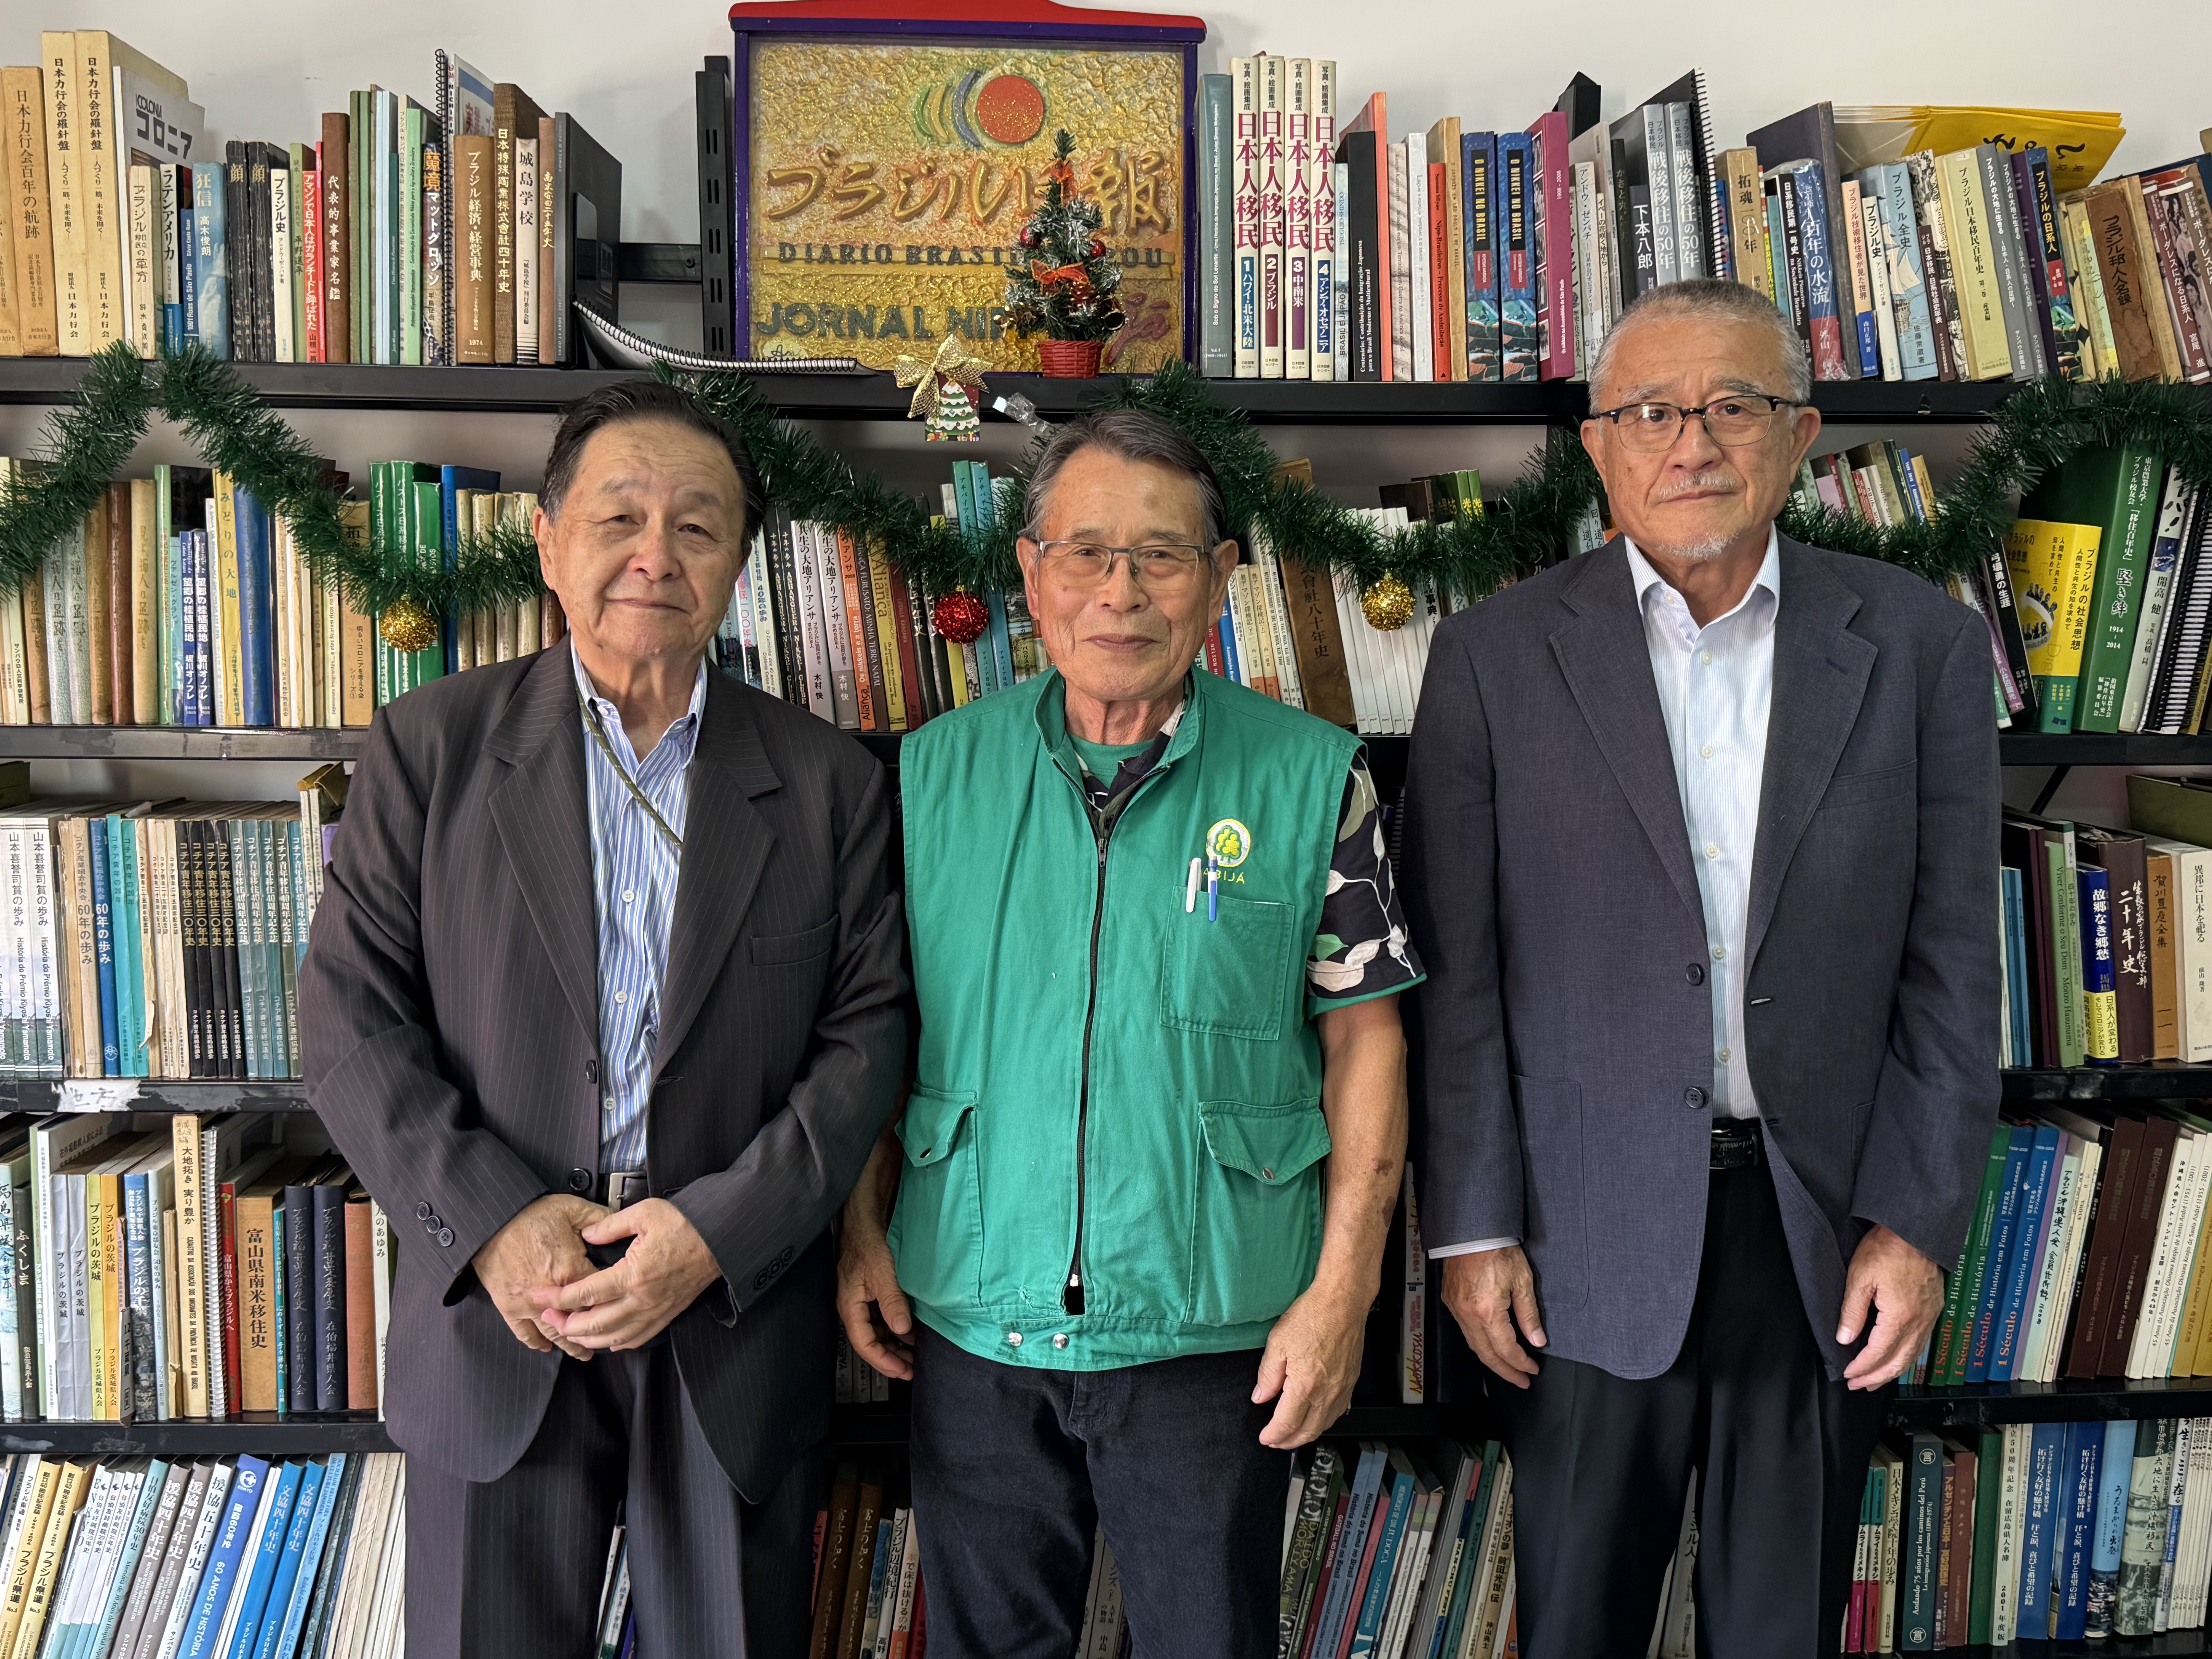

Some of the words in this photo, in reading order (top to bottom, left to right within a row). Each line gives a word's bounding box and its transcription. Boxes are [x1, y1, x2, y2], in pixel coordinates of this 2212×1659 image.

[53, 58, 70, 151] 日本力行会の羅針盤
[86, 57, 104, 151] 日本力行会の羅針盤
[135, 109, 193, 160] コロニア
[1648, 121, 1656, 148] 日本移民
[1656, 119, 1664, 148] ブラジル
[17, 89, 40, 239] 日本力行会百年の航跡
[230, 163, 245, 183] 顔
[252, 163, 266, 183] 顔
[423, 152, 442, 191] 魔境
[1235, 113, 1259, 251] 日本人移民
[1260, 111, 1283, 249] 日本人移民
[1287, 113, 1310, 251] 日本人移民
[1312, 115, 1336, 254] 日本人移民
[1475, 167, 1485, 194] NIKKEI
[1511, 167, 1520, 194] NIKKEI
[196, 173, 212, 208] 狂信
[274, 177, 287, 234] ブラジル史
[519, 152, 534, 226] 城島学校
[1475, 198, 1485, 209] NO
[1511, 198, 1521, 209] NO
[1580, 168, 1591, 240] アンドウ・ゼンパチ
[1649, 151, 1674, 270] 戦後移住の50年
[1892, 172, 1912, 250] ブラジル全史
[1986, 157, 2004, 234] ブラジルの大地に生きる
[2035, 170, 2058, 254] ブラジルの日系人
[161, 170, 175, 262] ラテンアメリカ
[200, 215, 211, 257] 高木俊朗
[328, 175, 342, 300] 代表的事業家名鑑
[428, 192, 441, 287] マットグロッソ
[468, 151, 483, 282] ブラジル経済・経営事典
[1476, 213, 1486, 241] BRASIL
[1511, 213, 1522, 241] BRASIL
[1633, 204, 1653, 270] 下本八郎
[1784, 182, 1800, 256] 日系移民第一号史
[1866, 204, 1882, 258] ブラジル史
[778, 242, 892, 265] DIARIO
[1244, 260, 1250, 272] 1
[1267, 258, 1276, 270] 2
[1293, 260, 1303, 273] 3
[1848, 187, 1868, 301] ブラジル技術移住者が見た世界
[1266, 272, 1277, 310] ブラジル
[1293, 274, 1304, 307] 中南米
[1319, 263, 1329, 275] 4
[2159, 221, 2193, 323] ボーダレスになる日系人
[757, 302, 933, 339] JORNAL
[1243, 273, 1254, 348] ハワイ・北米大陸
[1318, 276, 1329, 353] アジア・オセアニア
[221, 492, 238, 599] みどりの大地
[2052, 536, 2065, 593] 人間性と共生の
[861, 572, 872, 612] FURUSATO:
[871, 556, 891, 618] Aliança
[1991, 553, 2011, 609] 弓場勇の生涯
[2065, 548, 2083, 630] 人間性と共生の知を求めて
[2070, 548, 2097, 651] ブラジルの社会思想
[2111, 568, 2133, 617] 堅き絆
[2154, 575, 2168, 599] 開高
[183, 577, 194, 643] 望郷の桂植民地
[196, 577, 209, 643] 望郷の桂植民地
[866, 614, 875, 640] MINHA
[2109, 625, 2123, 634] 1914
[2151, 603, 2161, 615] 健
[356, 625, 364, 699] 明るいコロニアを考える会
[869, 641, 878, 663] TERRA
[2106, 641, 2121, 650] 2014
[814, 673, 822, 690] 木村
[839, 674, 848, 690] 木村
[840, 692, 849, 701] 快
[871, 665, 881, 687] NATAL
[859, 689, 871, 721] Aliança
[9, 832, 24, 927] 山本喜誉司賞の歩み
[34, 831, 48, 927] 山本喜誉司賞の歩み
[179, 842, 195, 946] コチア青年移住三〇年史
[193, 842, 207, 946] コチア青年移住三〇年史
[206, 842, 222, 946] コチア青年移住三〇年史
[219, 842, 235, 946] コチア青年移住三〇年史
[2056, 867, 2064, 886] Viver
[2057, 888, 2066, 927] Conforme
[2092, 889, 2110, 960] 故郷なき郷愁
[2194, 865, 2206, 943] 異邦に日本を祀る
[16, 937, 24, 962] História
[40, 937, 49, 962] História
[2118, 891, 2139, 974] 二十年史
[17, 963, 25, 972] do
[42, 963, 50, 972] do
[2060, 951, 2068, 970] Dom
[18, 974, 27, 997] Prêmio
[43, 974, 51, 997] Prêmio
[2062, 977, 2070, 1003] Monzo
[21, 1024, 31, 1060] Yamamoto
[46, 1024, 55, 1060] Yamamoto
[2063, 1006, 2072, 1046] Hasunuma
[2095, 997, 2105, 1056] そしてコロニアが変わる
[2106, 996, 2116, 1053] 日系人が変わる
[182, 1147, 193, 1183] 大地拓き
[183, 1188, 196, 1225] 実り豊か
[17, 1230, 30, 1285] ふくしま
[89, 1203, 101, 1281] ブラジルの茨城
[105, 1204, 116, 1273] ブラジルの茨城
[1996, 1250, 2004, 1262] em
[1998, 1225, 2009, 1248] Fotos
[2021, 1249, 2030, 1262] em
[2024, 1224, 2035, 1247] Fotos
[57, 1251, 68, 1318] ブラジルの茨城
[74, 1249, 85, 1316] ブラジルの茨城
[223, 1254, 235, 1331] 富山県からブラジルへ
[247, 1228, 268, 1349] 富山県南米移住史
[1989, 1264, 2001, 1297] História
[2014, 1263, 2027, 1295] História
[1987, 1299, 1995, 1309] de
[2012, 1298, 2020, 1308] de
[1974, 1311, 1993, 1358] Século
[1998, 1310, 2018, 1357] Século
[325, 1321, 337, 1396] 在伯福井県人会
[1997, 1358, 2008, 1367] 1
[144, 1479, 180, 1561] 援協四十年史
[168, 1479, 204, 1561] 援協四十年史
[188, 1476, 227, 1571] 援協五十年史
[264, 1484, 292, 1554] 文協四十年史
[289, 1483, 316, 1552] 文協四十年史
[1917, 1506, 1925, 1533] caminos
[33, 1551, 55, 1605] ブラジル県連
[214, 1560, 225, 1574] 60
[884, 1517, 907, 1599] ブラジル辺境紀行
[1285, 1520, 1307, 1593] MORIYAMA
[1914, 1575, 1921, 1584] 75
[202, 1602, 213, 1616] DE
[206, 1574, 221, 1602] ANOS
[190, 1616, 209, 1658] HISTÓRIA
[876, 1637, 887, 1654] 高野
